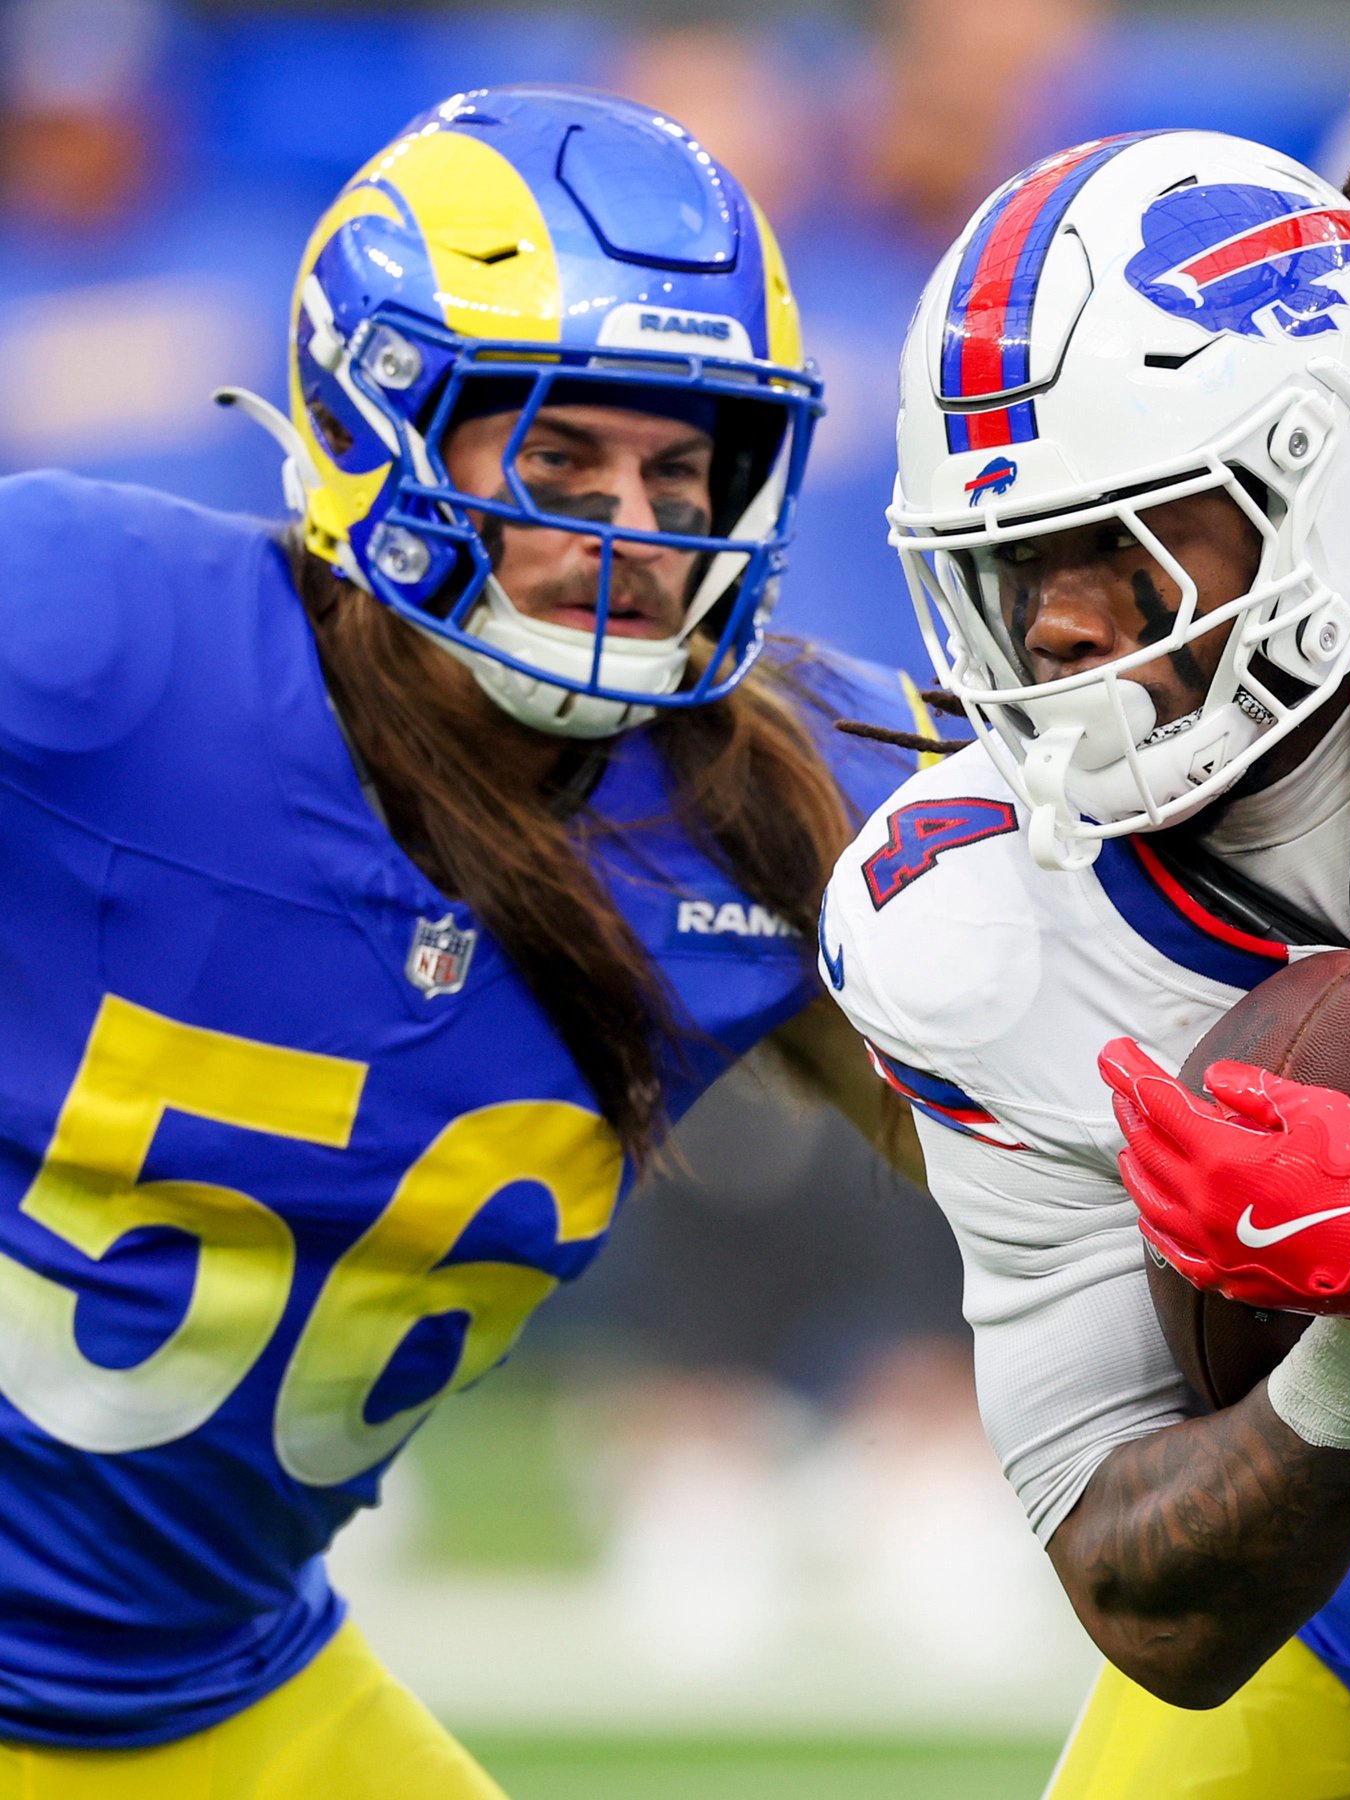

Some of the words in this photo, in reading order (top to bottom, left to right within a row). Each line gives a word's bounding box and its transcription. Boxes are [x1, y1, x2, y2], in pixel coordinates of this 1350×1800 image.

[640, 313, 730, 340] RAMS
[861, 796, 1019, 912] 4
[678, 901, 802, 938] RAM
[0, 993, 624, 1486] 56
